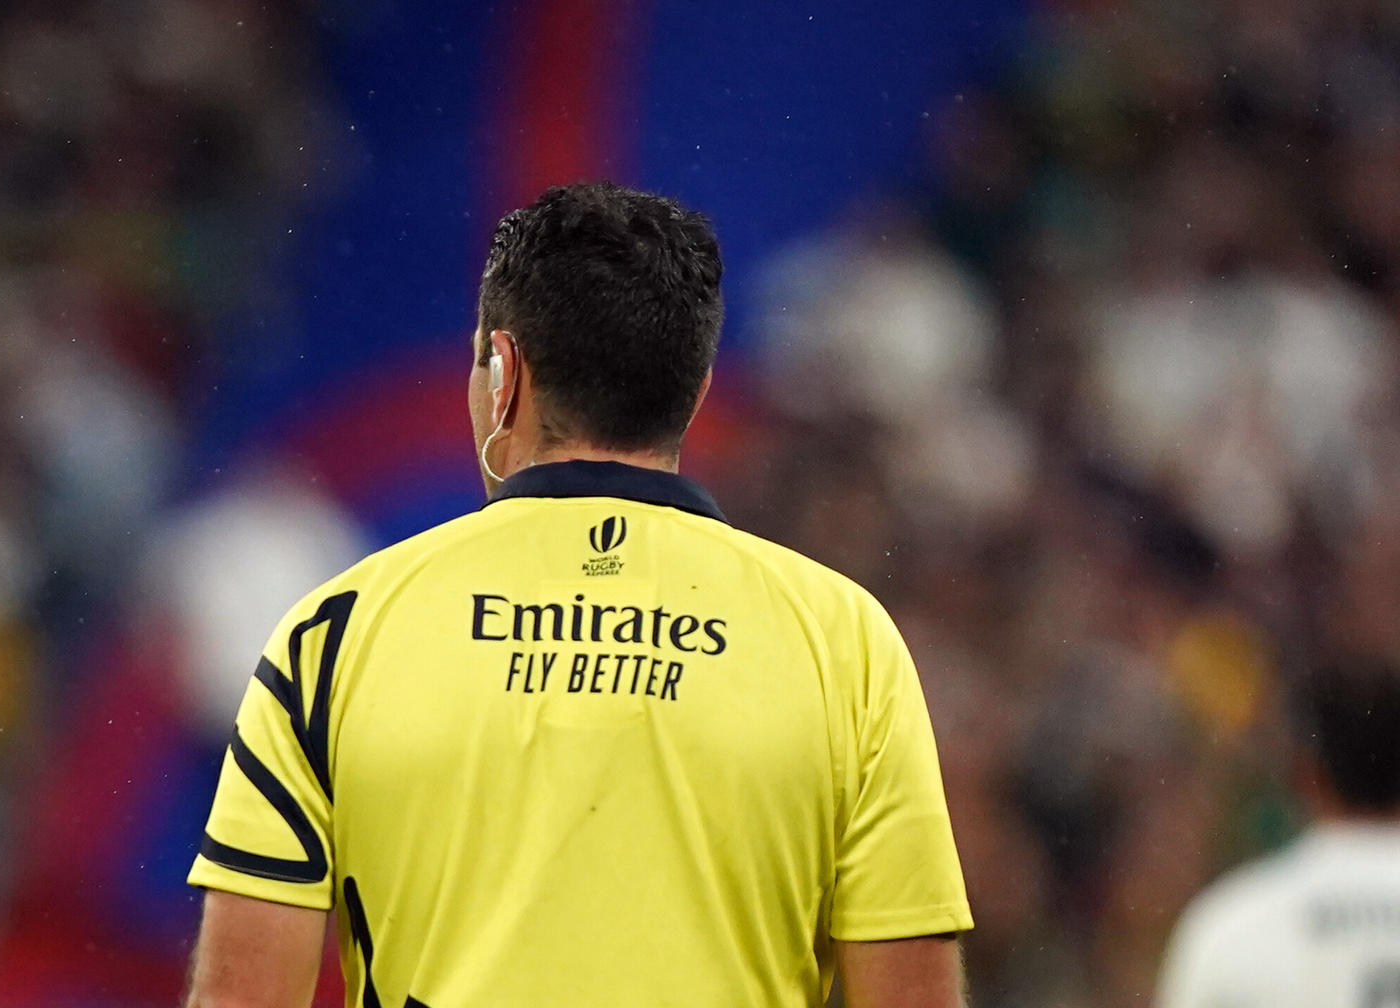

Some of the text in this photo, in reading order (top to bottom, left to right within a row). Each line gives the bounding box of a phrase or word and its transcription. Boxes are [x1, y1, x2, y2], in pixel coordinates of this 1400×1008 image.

[582, 561, 624, 571] RUGBY
[472, 594, 728, 656] Emirates
[506, 652, 684, 701] FLY BETTER
